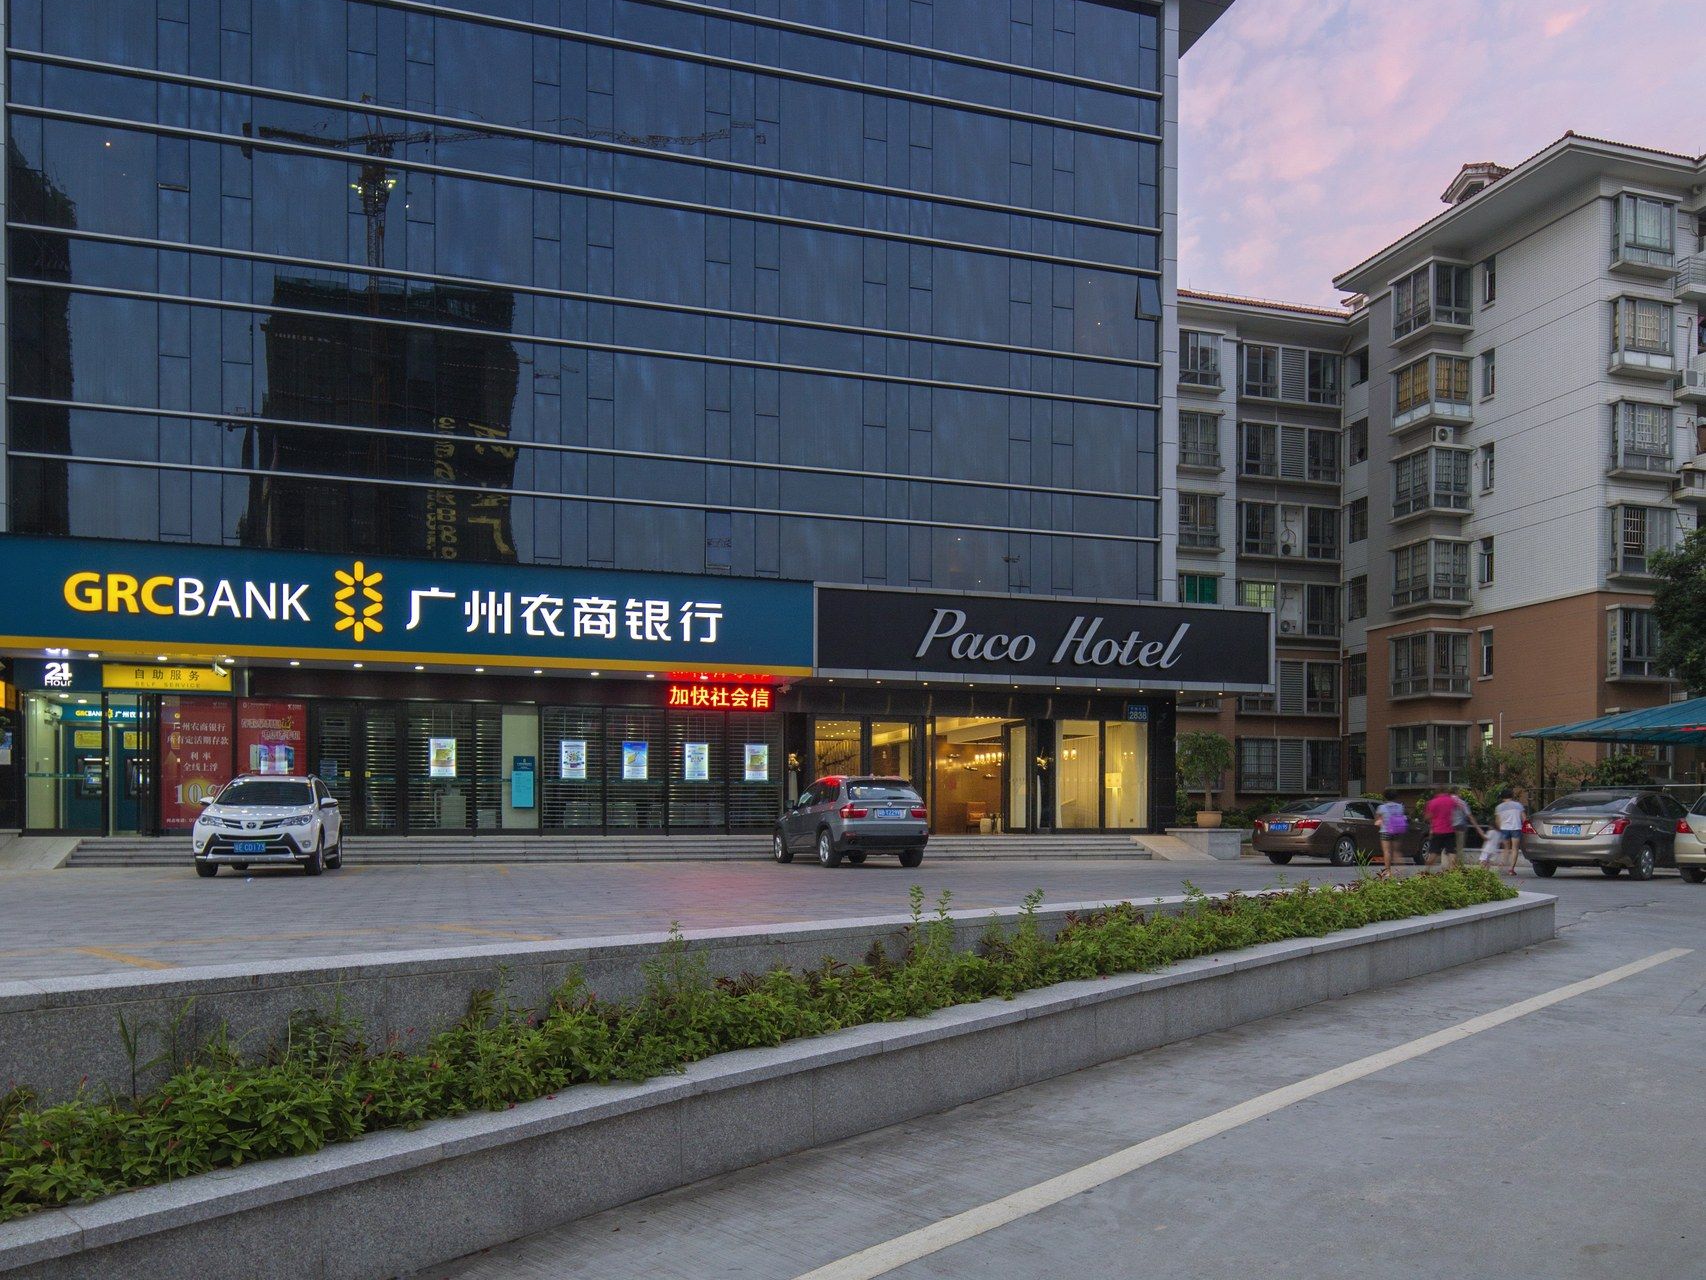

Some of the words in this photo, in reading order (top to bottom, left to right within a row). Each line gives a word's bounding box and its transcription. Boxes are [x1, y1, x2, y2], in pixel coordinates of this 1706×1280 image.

[63, 571, 311, 622] GRCBANK
[406, 586, 724, 644] 广州农商银行
[915, 608, 1037, 662] Paco
[1051, 616, 1191, 669] Hotel
[45, 662, 73, 680] 24
[134, 668, 200, 682] 自助服务
[669, 685, 770, 708] 加快社会信
